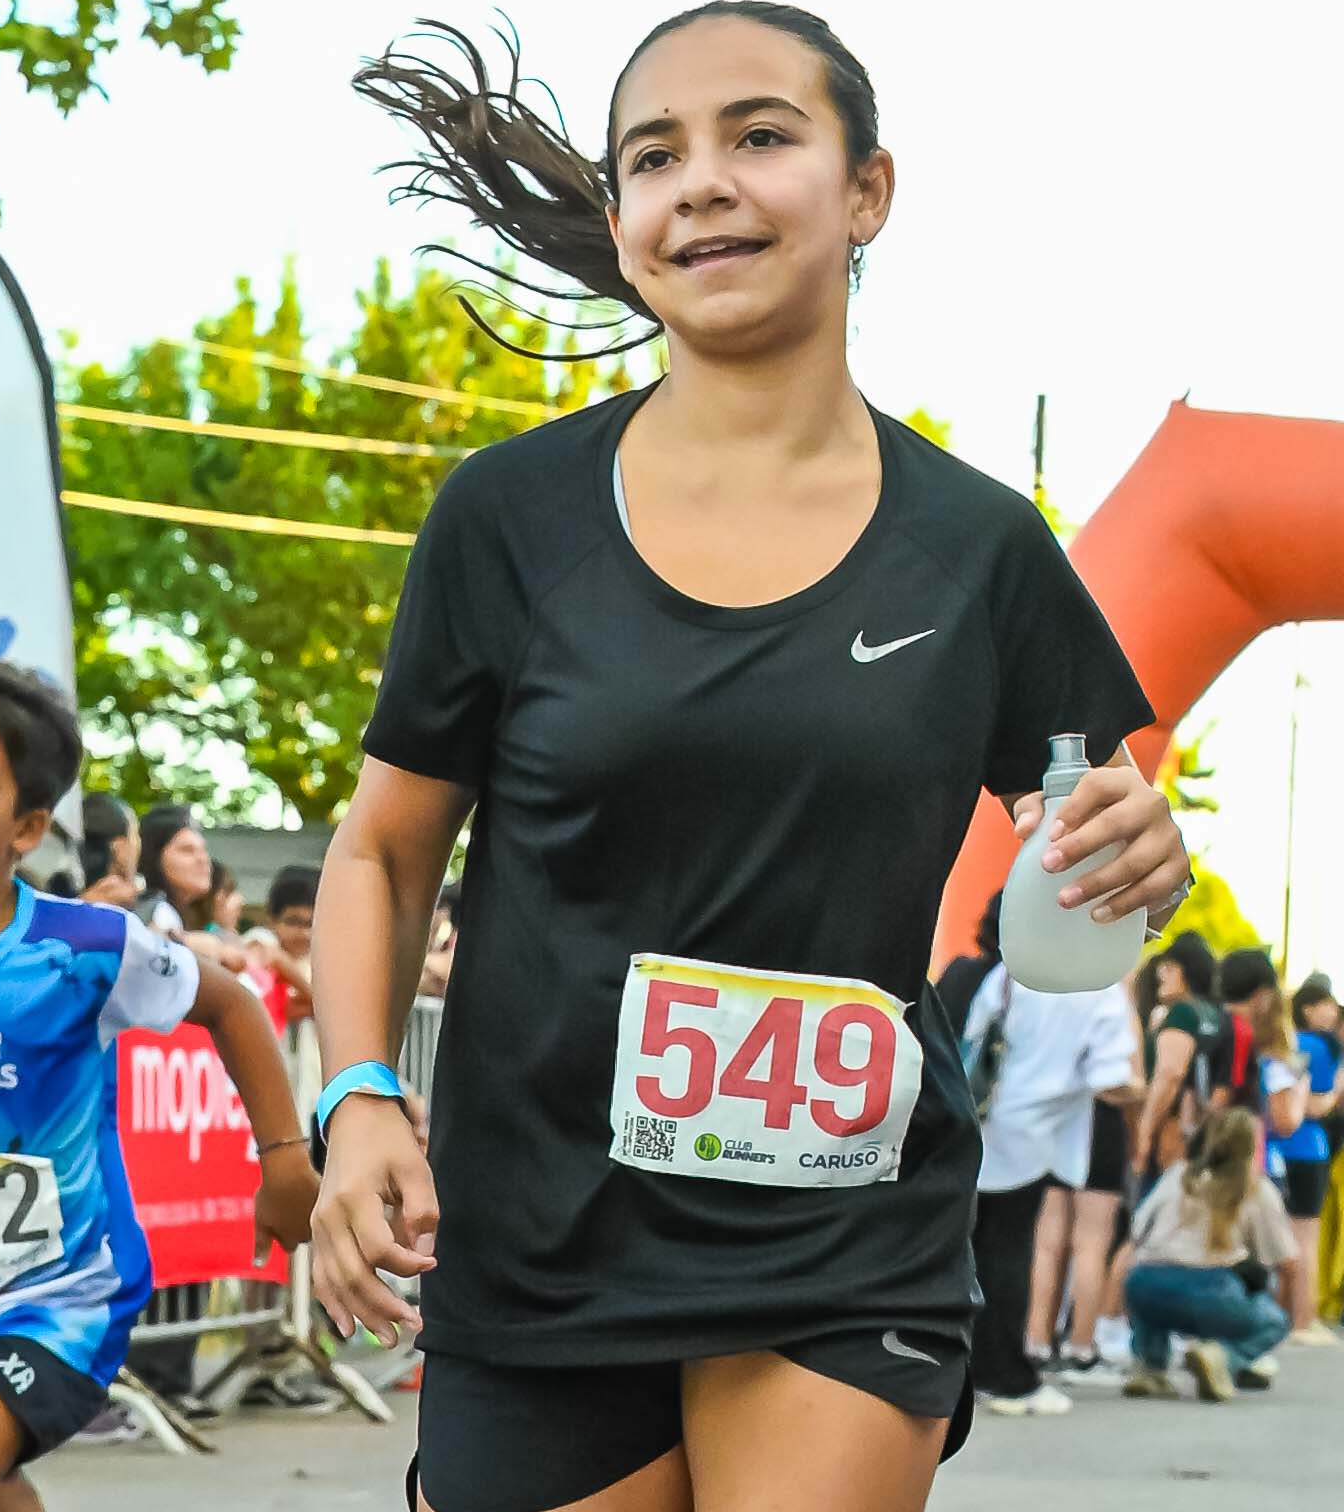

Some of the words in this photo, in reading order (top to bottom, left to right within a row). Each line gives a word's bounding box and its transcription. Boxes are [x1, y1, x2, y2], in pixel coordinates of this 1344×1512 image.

[635, 979, 897, 1138] 549
[131, 1045, 260, 1163] mople
[725, 1139, 753, 1151] CLUB
[799, 1150, 879, 1169] CARUSO
